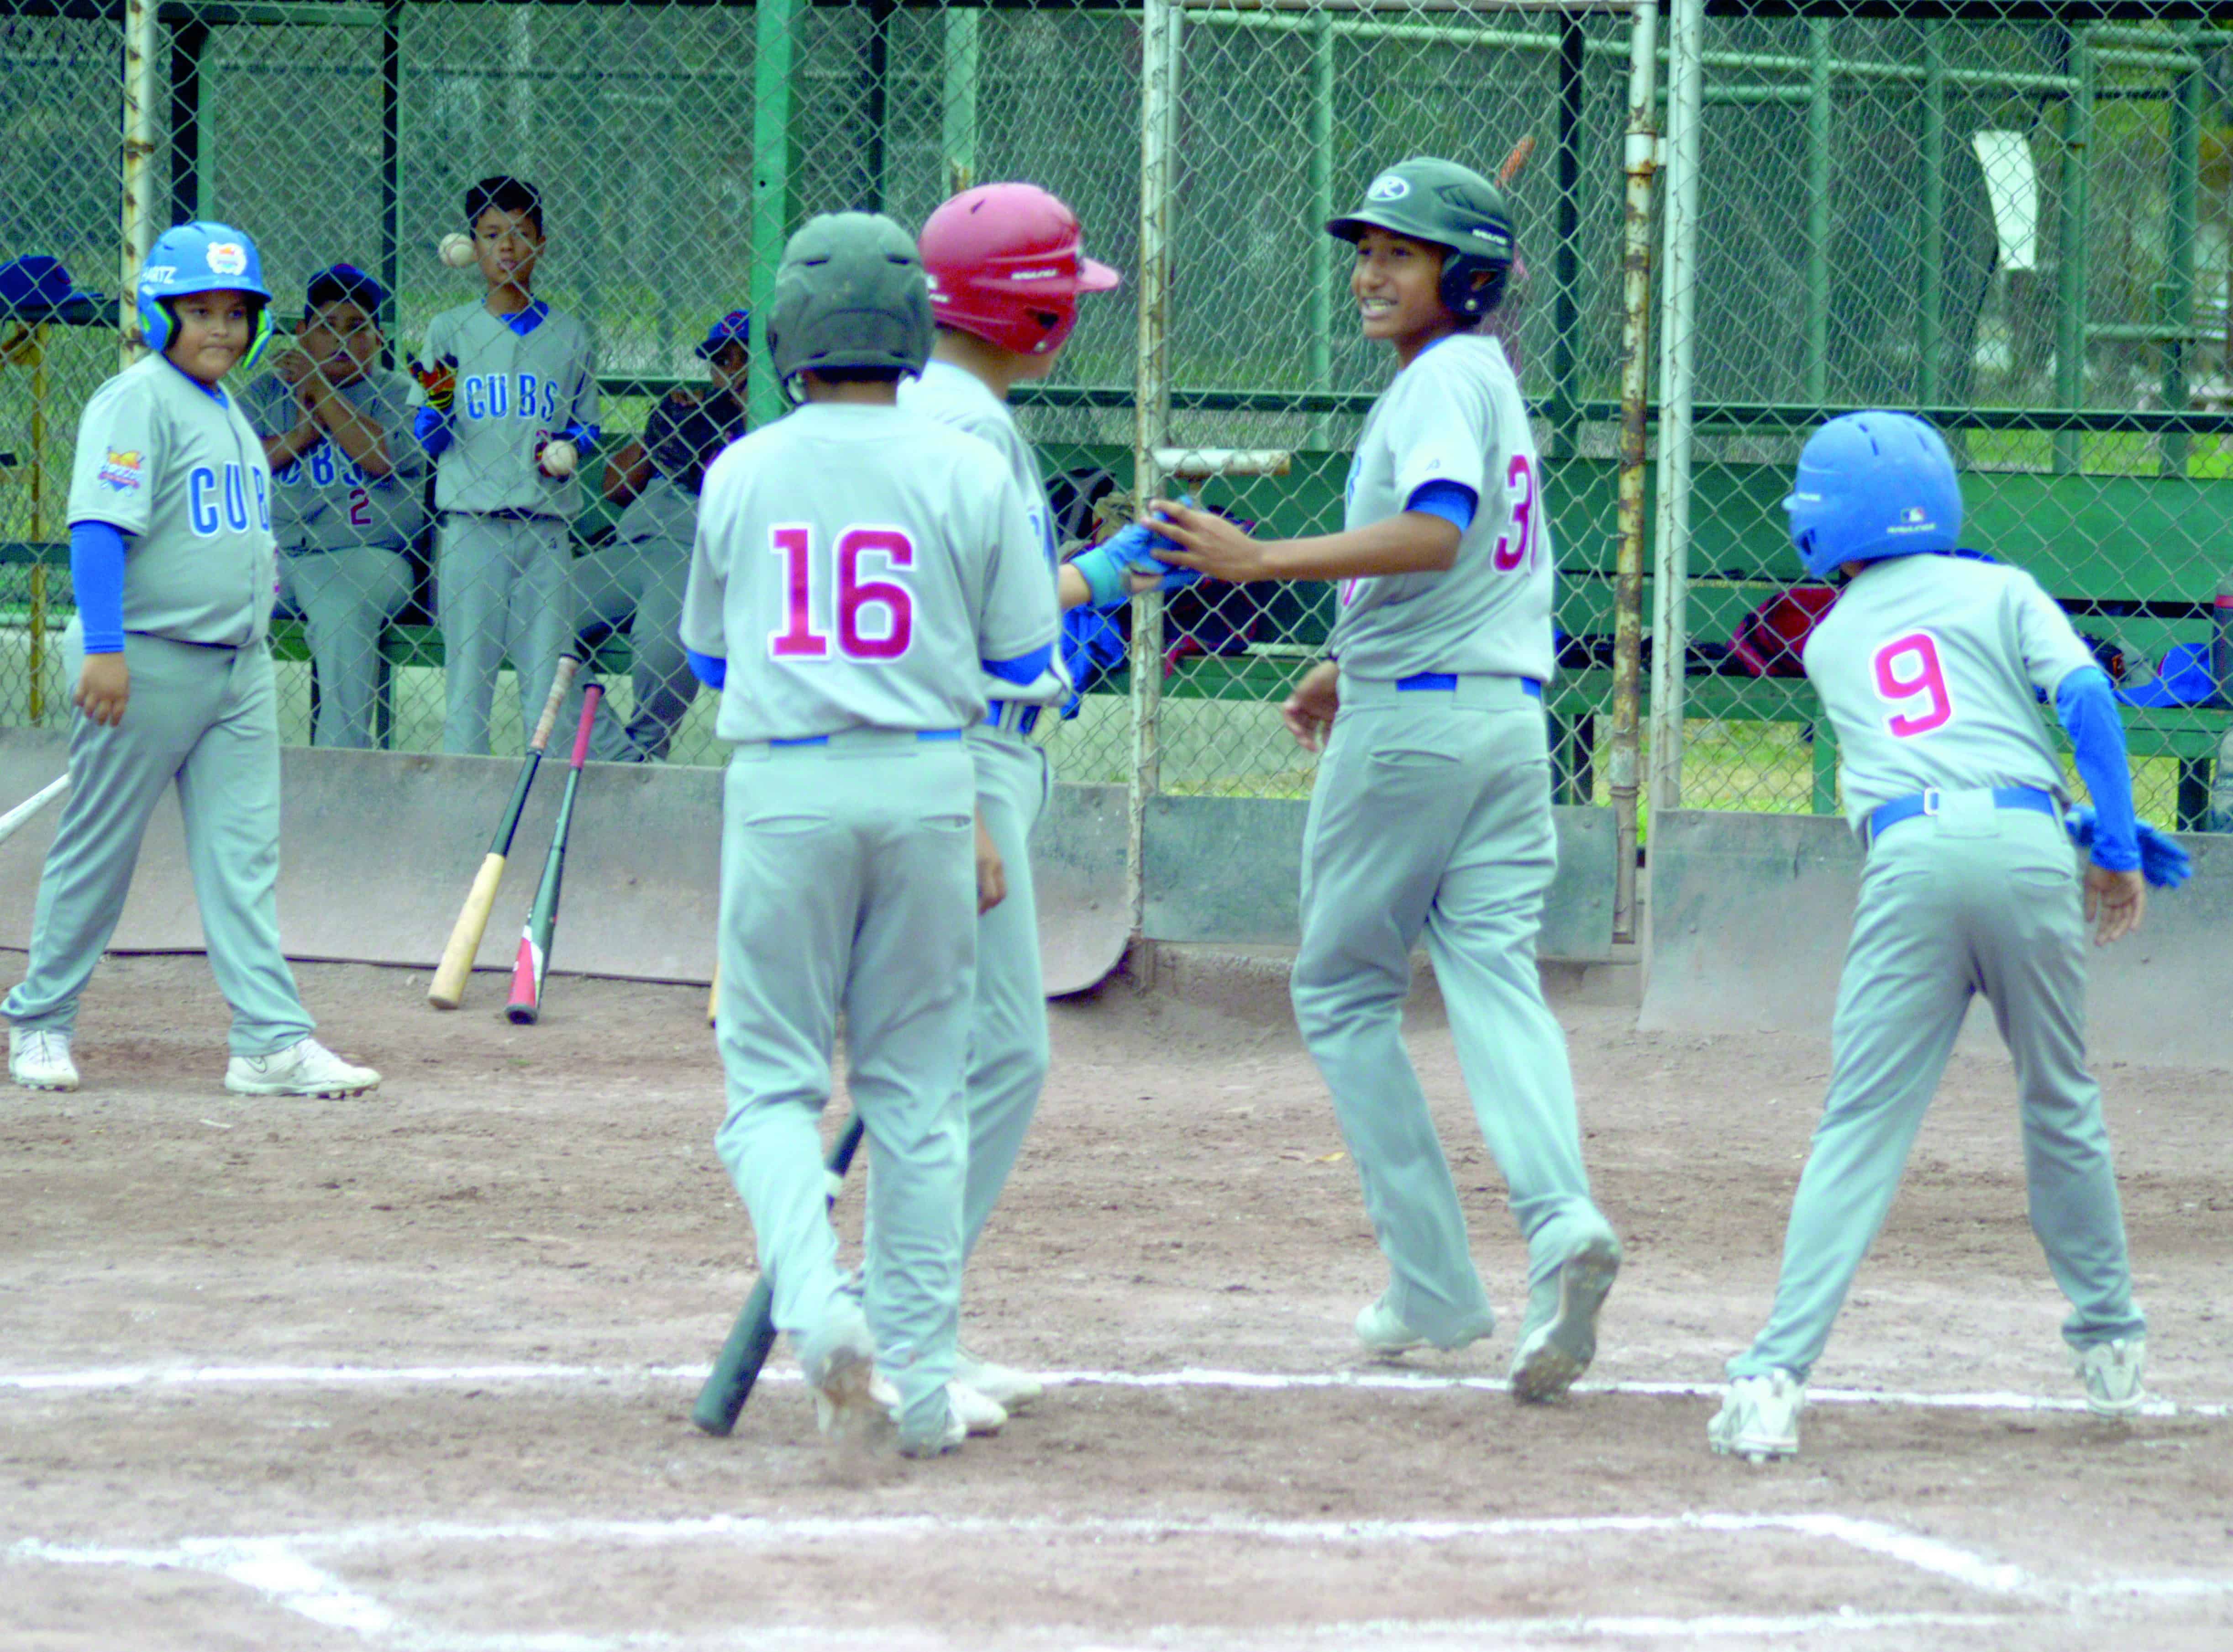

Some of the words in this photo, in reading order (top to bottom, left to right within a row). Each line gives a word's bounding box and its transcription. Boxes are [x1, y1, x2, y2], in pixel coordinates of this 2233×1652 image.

[464, 373, 558, 423] CUBS
[349, 488, 372, 526] 2
[767, 522, 916, 664] 16
[1870, 629, 1955, 740] 9
